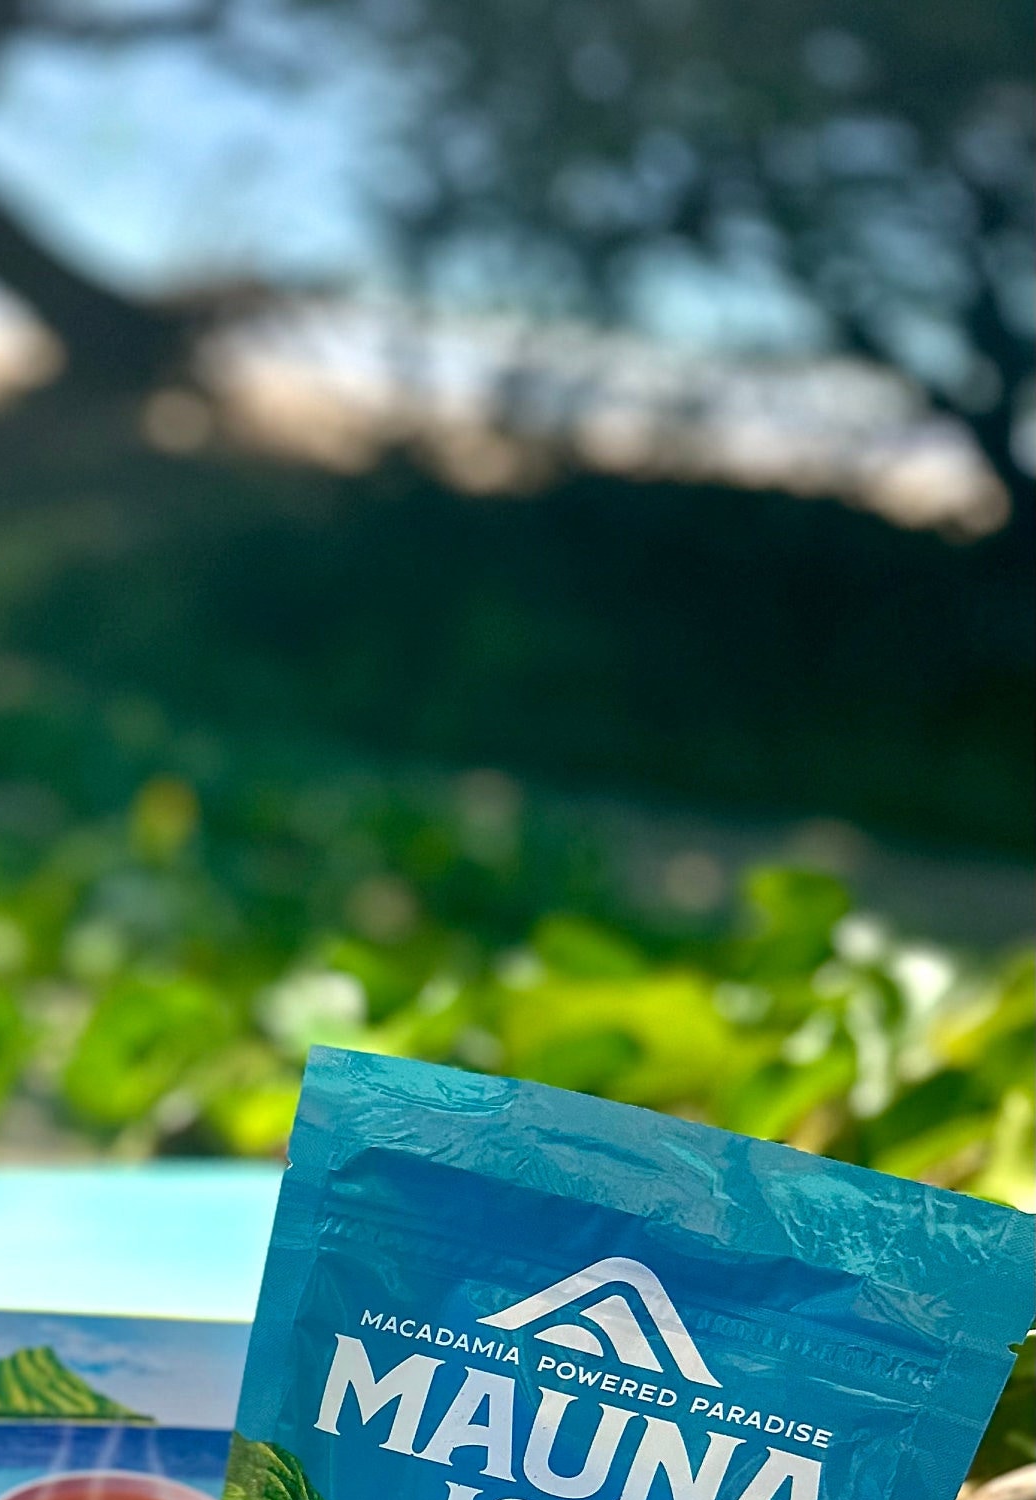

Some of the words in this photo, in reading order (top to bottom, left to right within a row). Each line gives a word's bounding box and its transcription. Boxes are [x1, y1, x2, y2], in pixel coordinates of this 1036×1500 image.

[360, 1308, 521, 1366] MACADAMIA
[537, 1355, 679, 1408] POWERED
[690, 1397, 834, 1449] PARADISE
